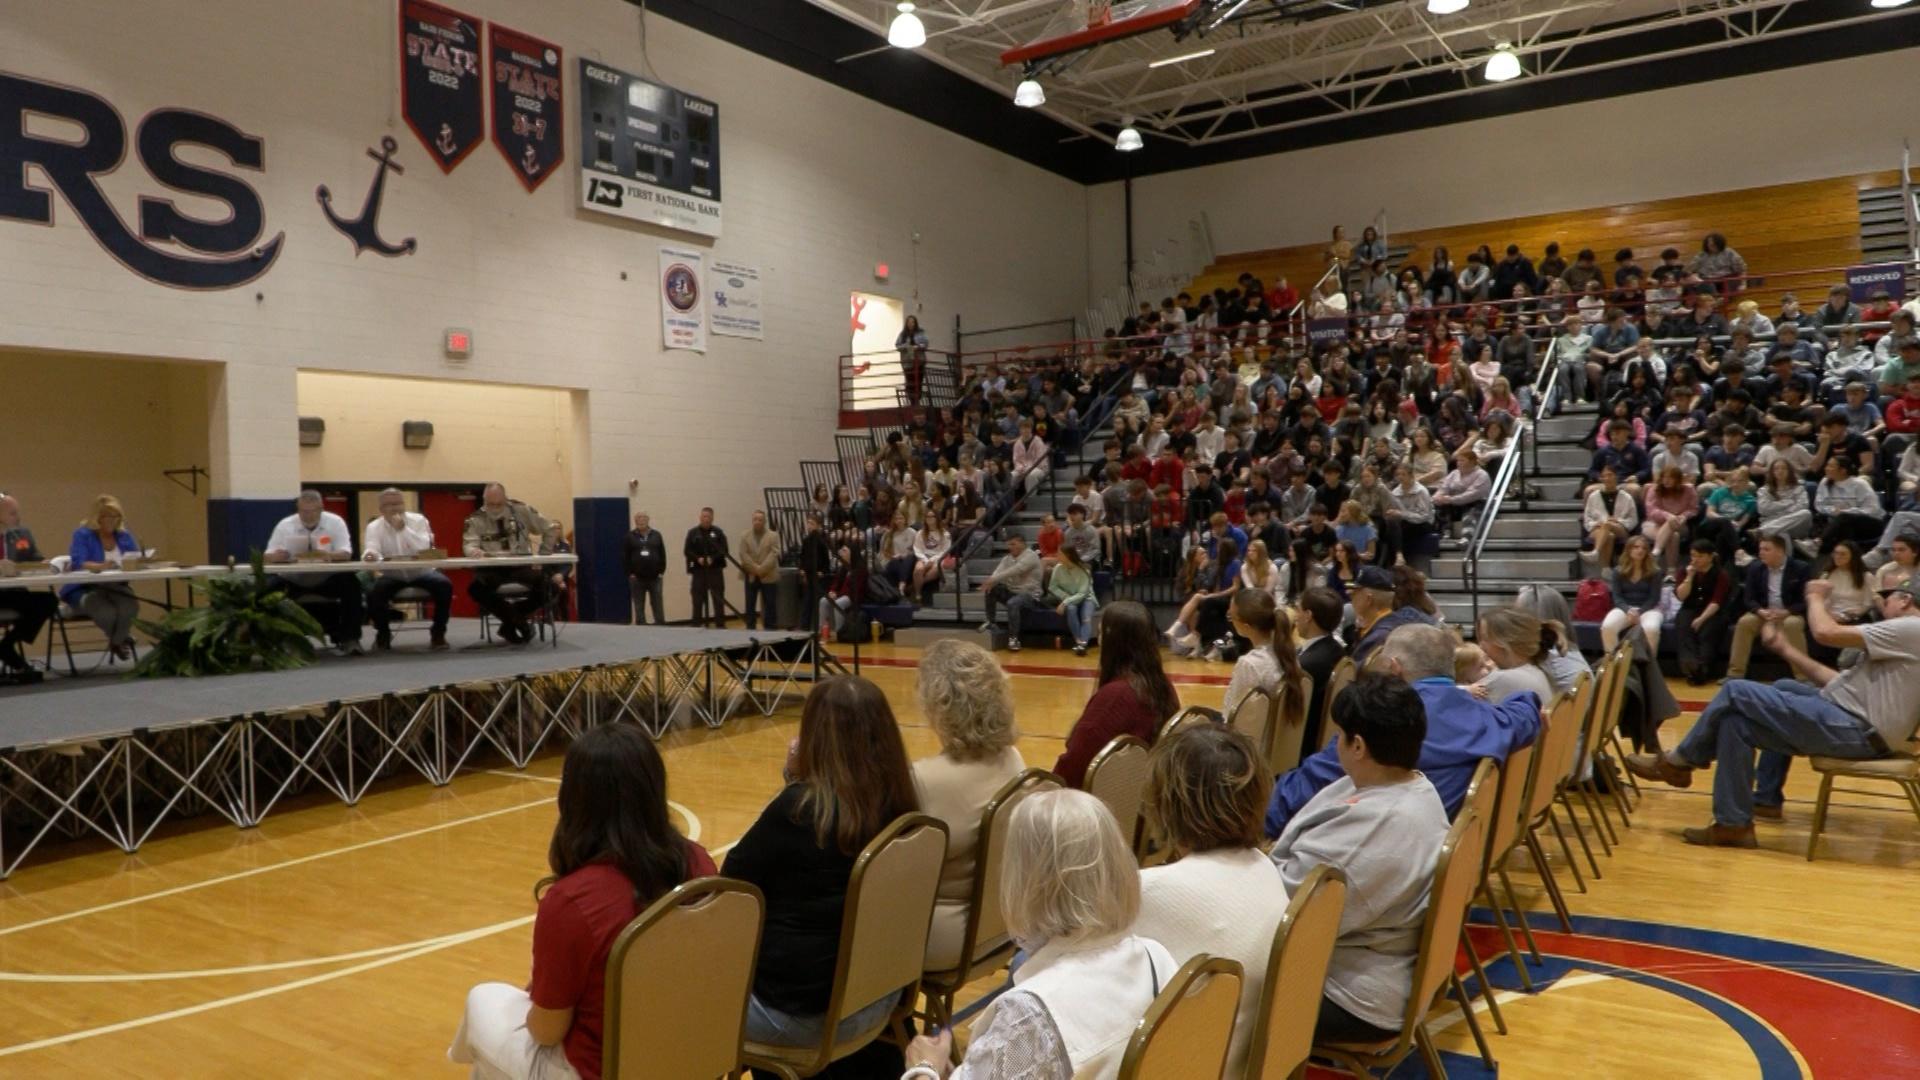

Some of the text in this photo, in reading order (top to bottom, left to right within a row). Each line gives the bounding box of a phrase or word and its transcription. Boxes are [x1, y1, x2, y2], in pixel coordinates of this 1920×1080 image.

[406, 33, 479, 76] STATE
[428, 69, 460, 90] 2022
[496, 61, 560, 101] STATE
[586, 65, 621, 85] GUEST
[514, 94, 542, 114] 2022
[684, 98, 715, 117] LAKERS
[627, 186, 653, 203] FIRST
[655, 192, 696, 213] NATIONAL
[698, 203, 720, 218] BANK
[1849, 271, 1901, 284] RESERVED
[1309, 328, 1346, 340] VISITOR
